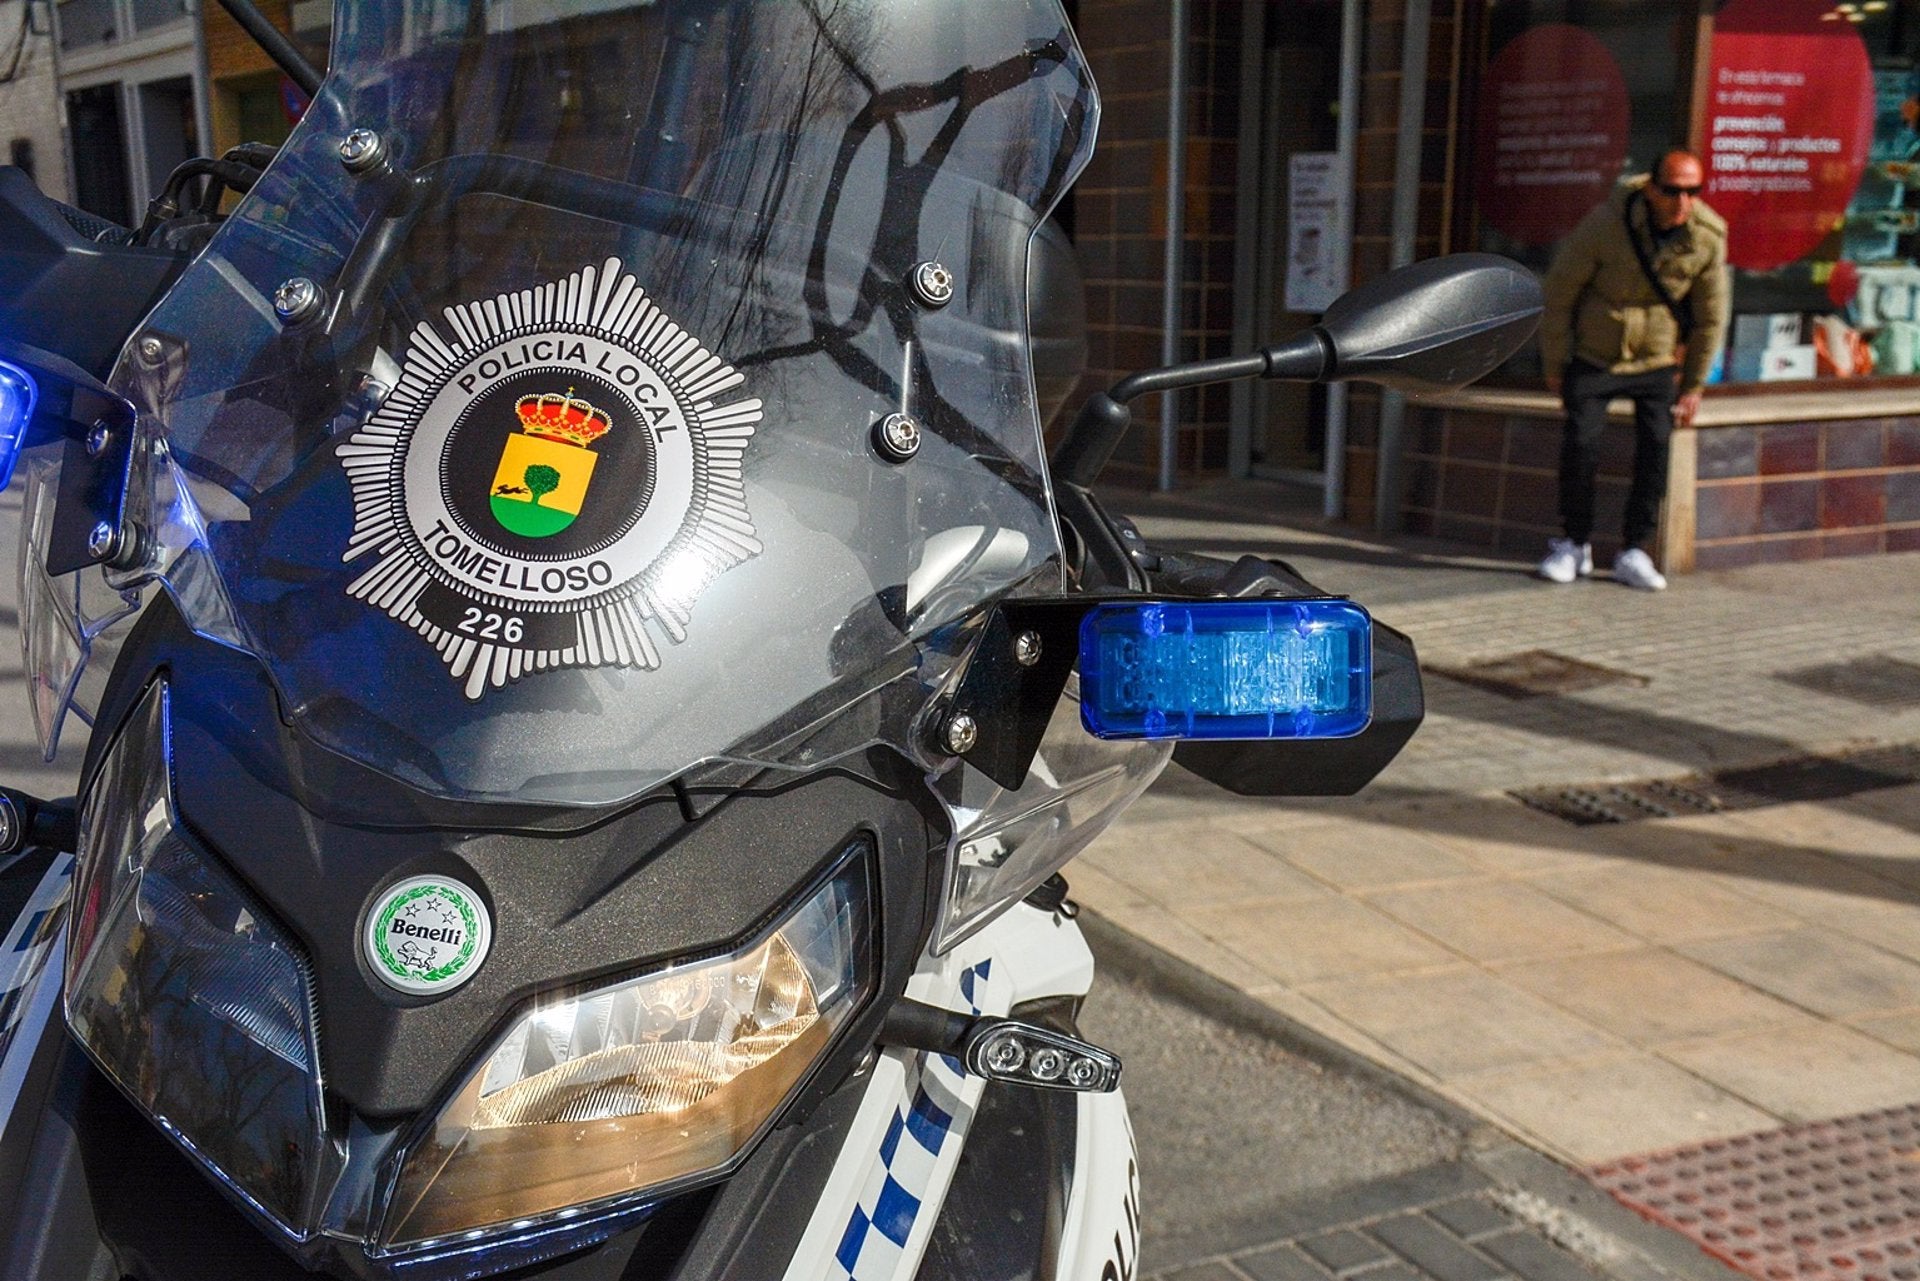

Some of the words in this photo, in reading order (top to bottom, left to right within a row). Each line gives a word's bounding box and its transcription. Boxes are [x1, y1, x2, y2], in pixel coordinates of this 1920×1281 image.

[457, 339, 588, 395] POLICIA
[600, 348, 679, 444] LOCAL
[422, 518, 613, 594] TOMELLOSO
[457, 607, 524, 643] 226
[391, 918, 462, 946] Benelli
